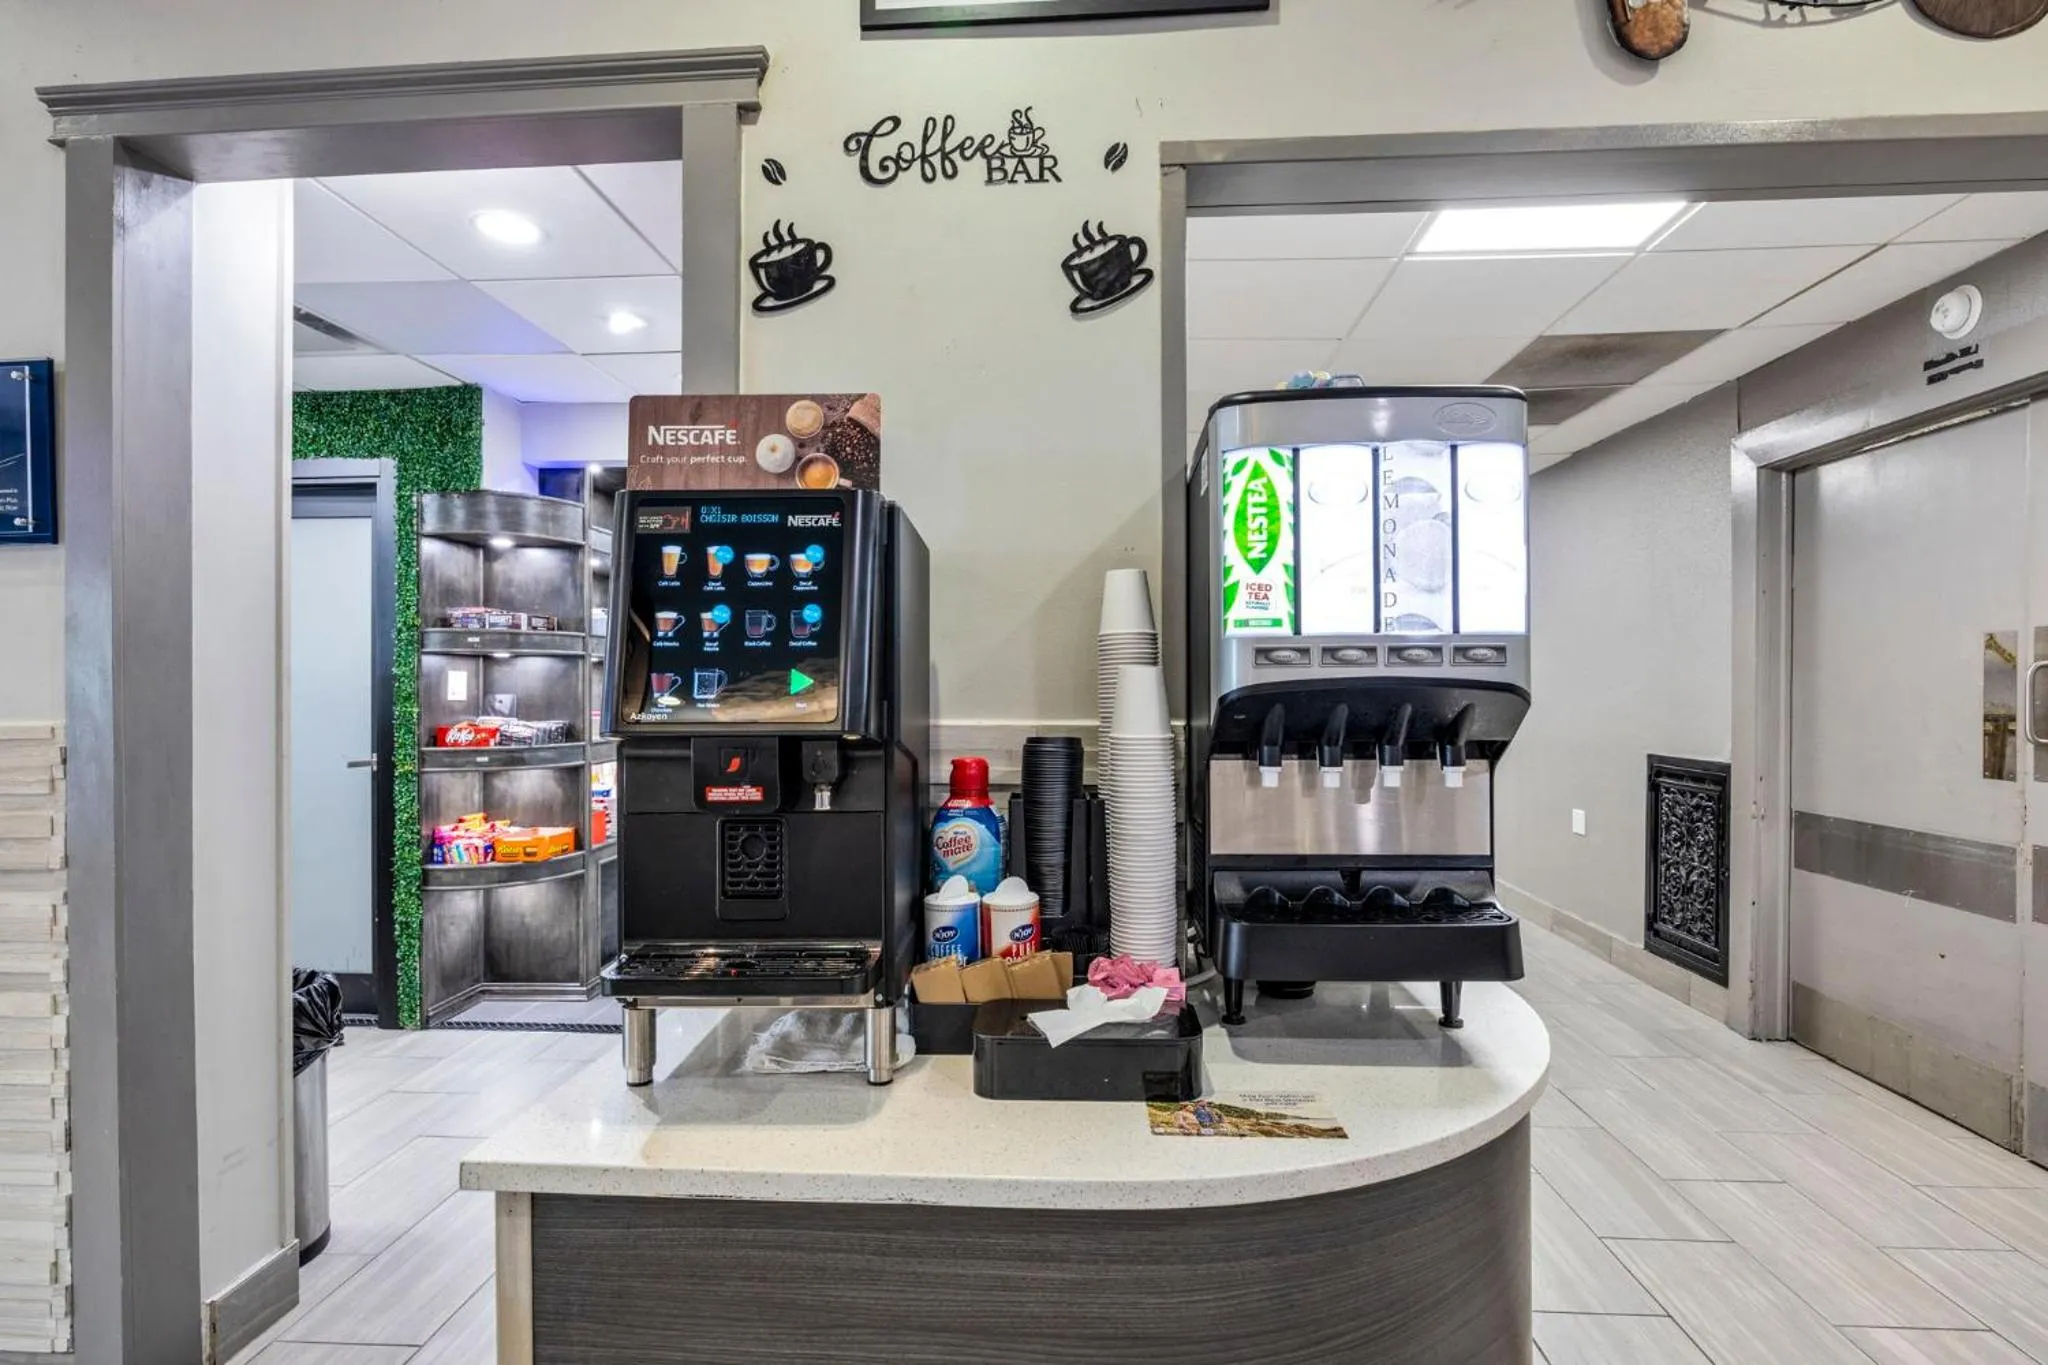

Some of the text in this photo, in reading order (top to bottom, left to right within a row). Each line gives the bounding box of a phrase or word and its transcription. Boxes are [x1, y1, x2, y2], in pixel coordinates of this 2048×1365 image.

[843, 114, 1004, 185] Coffee
[985, 155, 1062, 184] BAR
[640, 455, 664, 464] Craft
[666, 456, 686, 465] your
[690, 454, 725, 465] perfect
[1247, 476, 1268, 559] NESTEA
[1382, 446, 1399, 633] LEMONADE
[1245, 582, 1273, 592] ICED
[1248, 592, 1270, 601] TEA
[935, 835, 972, 850] Coffee
[942, 844, 974, 858] mate
